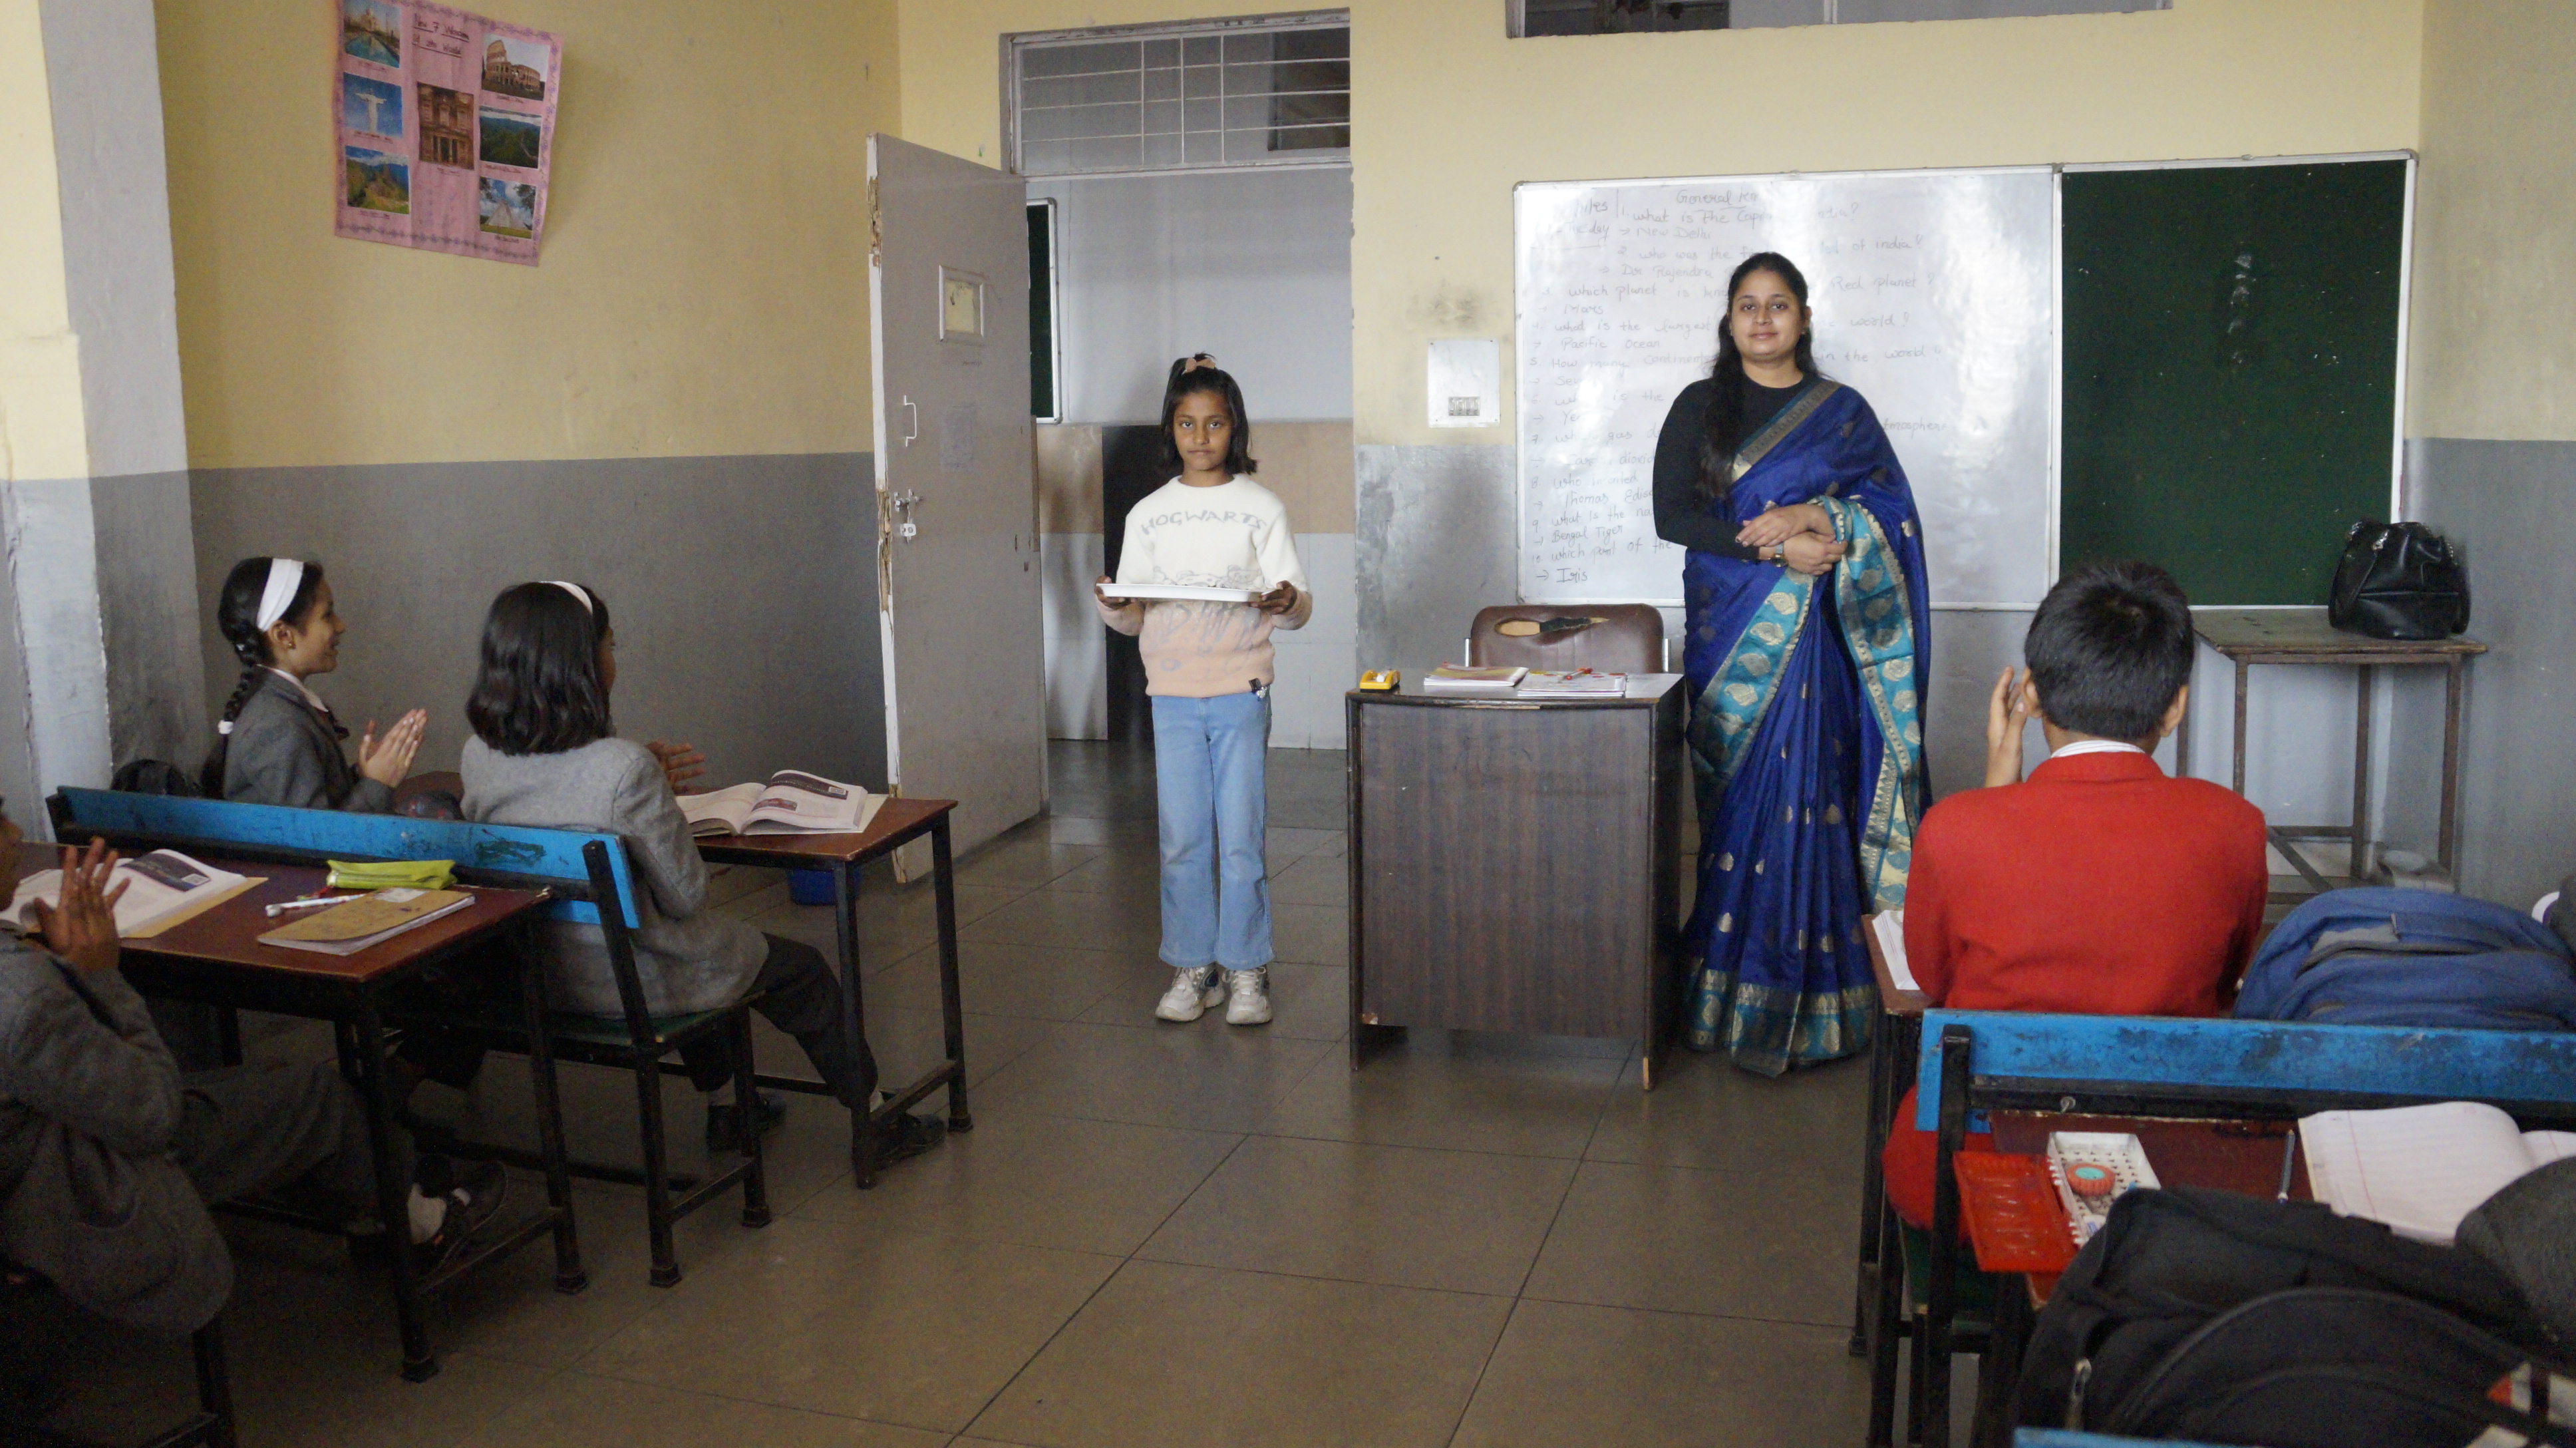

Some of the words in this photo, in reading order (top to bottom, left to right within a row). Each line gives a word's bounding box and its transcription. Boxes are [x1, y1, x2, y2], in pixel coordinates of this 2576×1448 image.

[1677, 189, 1733, 206] General
[1633, 208, 1669, 222] what
[1681, 211, 1694, 224] is
[1637, 227, 1668, 237] New
[1674, 227, 1711, 239] Delhi
[1639, 250, 1667, 260] who
[1676, 251, 1697, 260] was
[1710, 246, 1732, 260] the
[1852, 238, 1865, 250] of
[1568, 285, 1609, 297] which
[1615, 285, 1657, 301] planet
[1677, 289, 1690, 297] is
[1831, 275, 1863, 291] Red
[1873, 272, 1917, 295] planet
[1564, 303, 1604, 315] Mars
[1598, 319, 1610, 330] is
[1619, 321, 1641, 331] the
[1850, 314, 1896, 327] world
[1561, 337, 1608, 351] Pacific
[1551, 358, 1578, 369] How
[1845, 349, 1869, 362] the
[1884, 345, 1925, 359] world
[1613, 391, 1627, 401] is
[1641, 390, 1665, 402] the
[1607, 432, 1633, 445] gas
[1883, 417, 1948, 439] tmosphere
[1619, 451, 1655, 464] dioxid
[1553, 473, 1581, 489] who
[1565, 490, 1609, 508] Thomas
[1140, 510, 1267, 535] HOGWARTS
[1551, 511, 1581, 528] what
[1607, 504, 1625, 520] the
[1551, 526, 1587, 548] Bengal
[1596, 524, 1623, 544] Tiger
[1551, 548, 1585, 562] which
[1652, 536, 1672, 554] the
[1555, 567, 1588, 584] Iris
